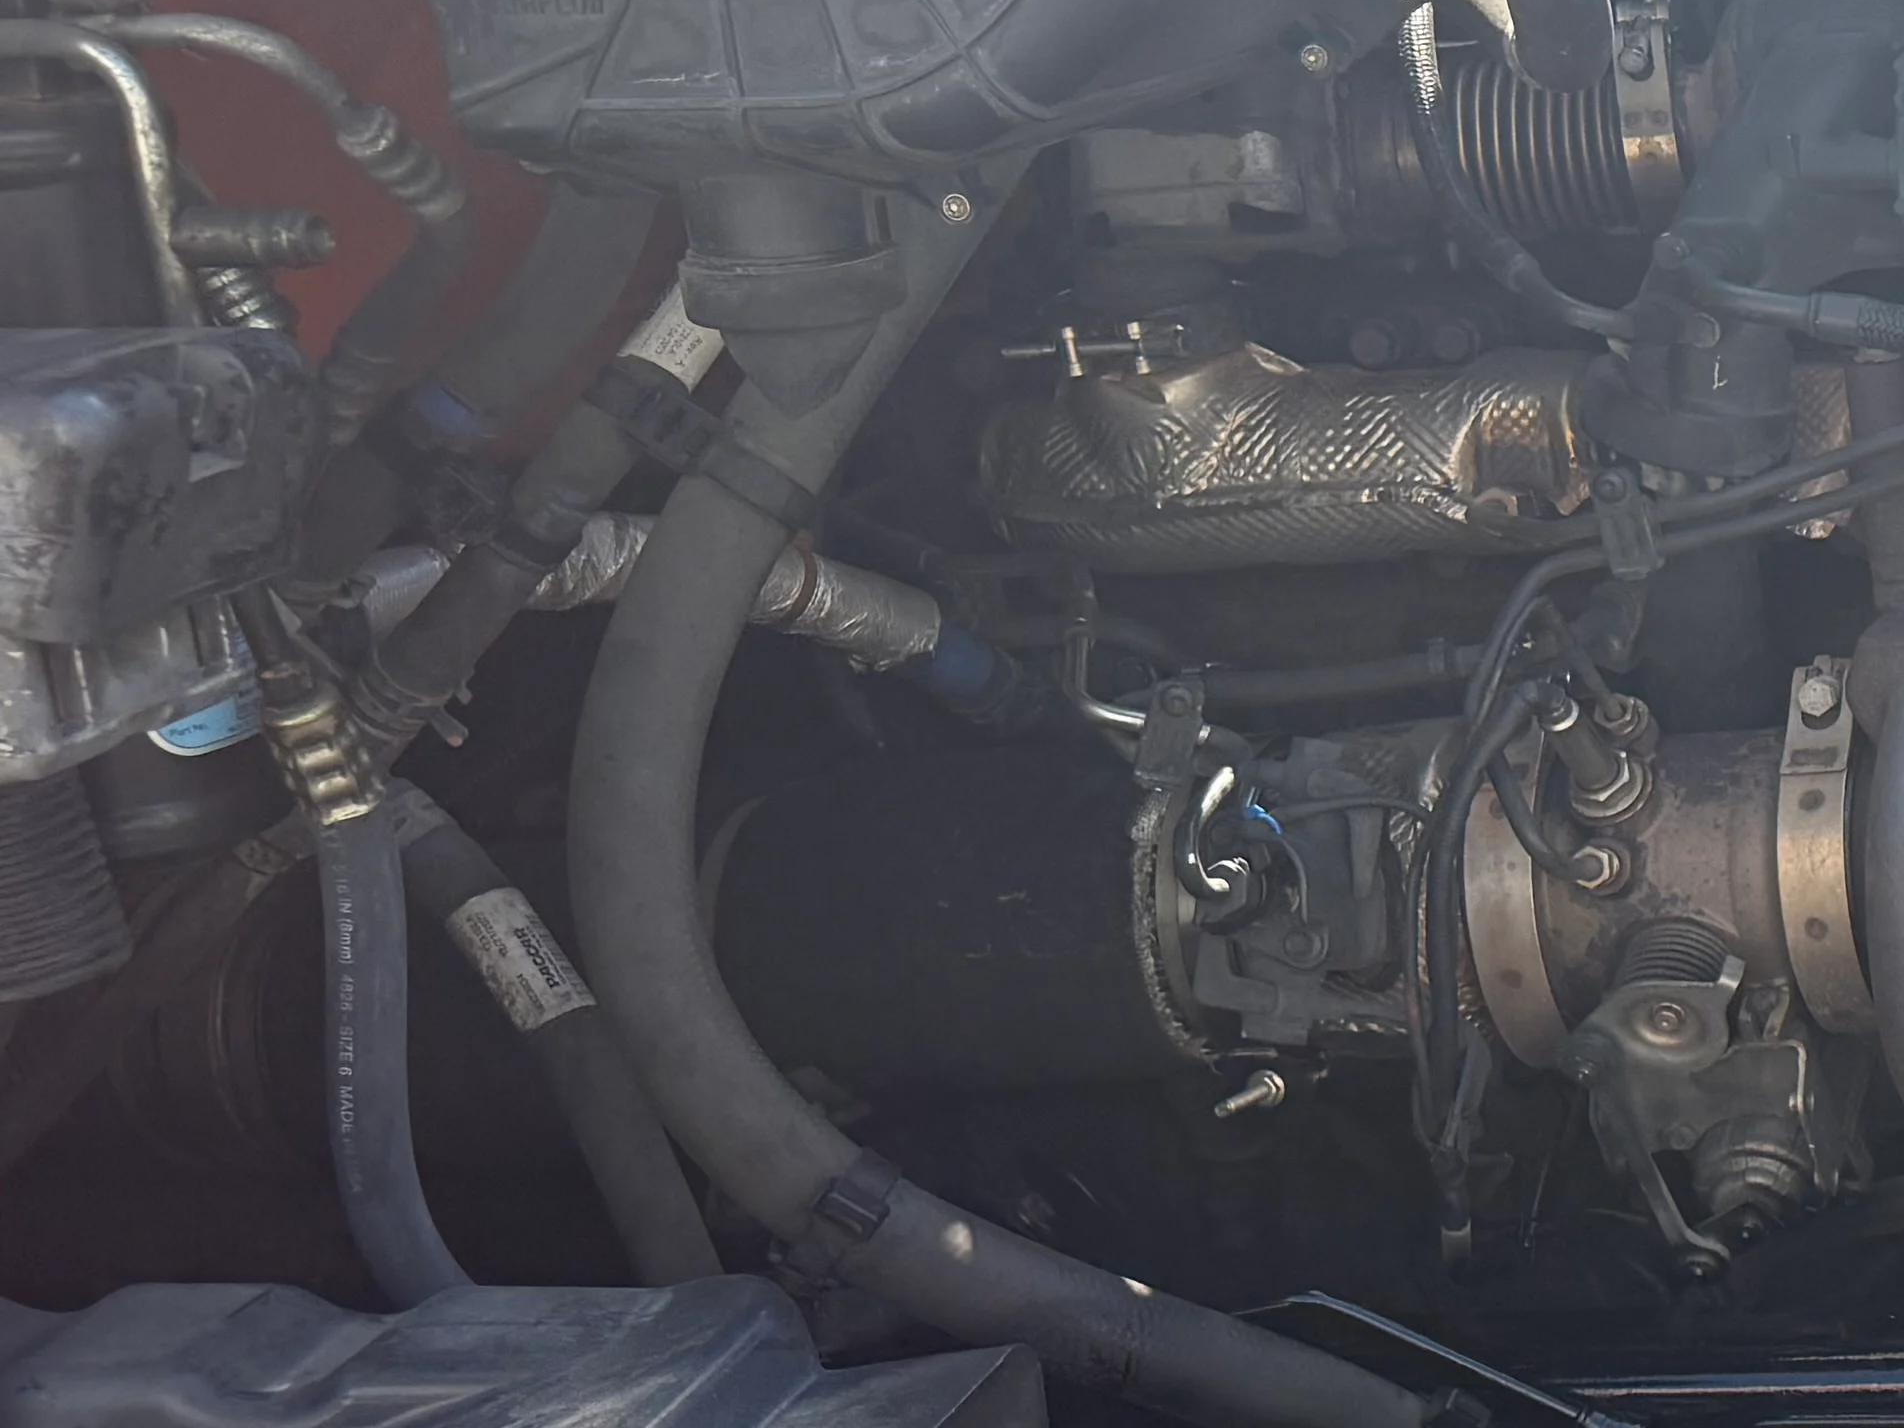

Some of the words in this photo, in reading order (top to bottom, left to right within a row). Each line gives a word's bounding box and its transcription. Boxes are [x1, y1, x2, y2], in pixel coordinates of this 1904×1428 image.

[512, 924, 561, 992] PACCAR
[338, 1026, 355, 1061] SIZE
[339, 1085, 356, 1134] MADE
